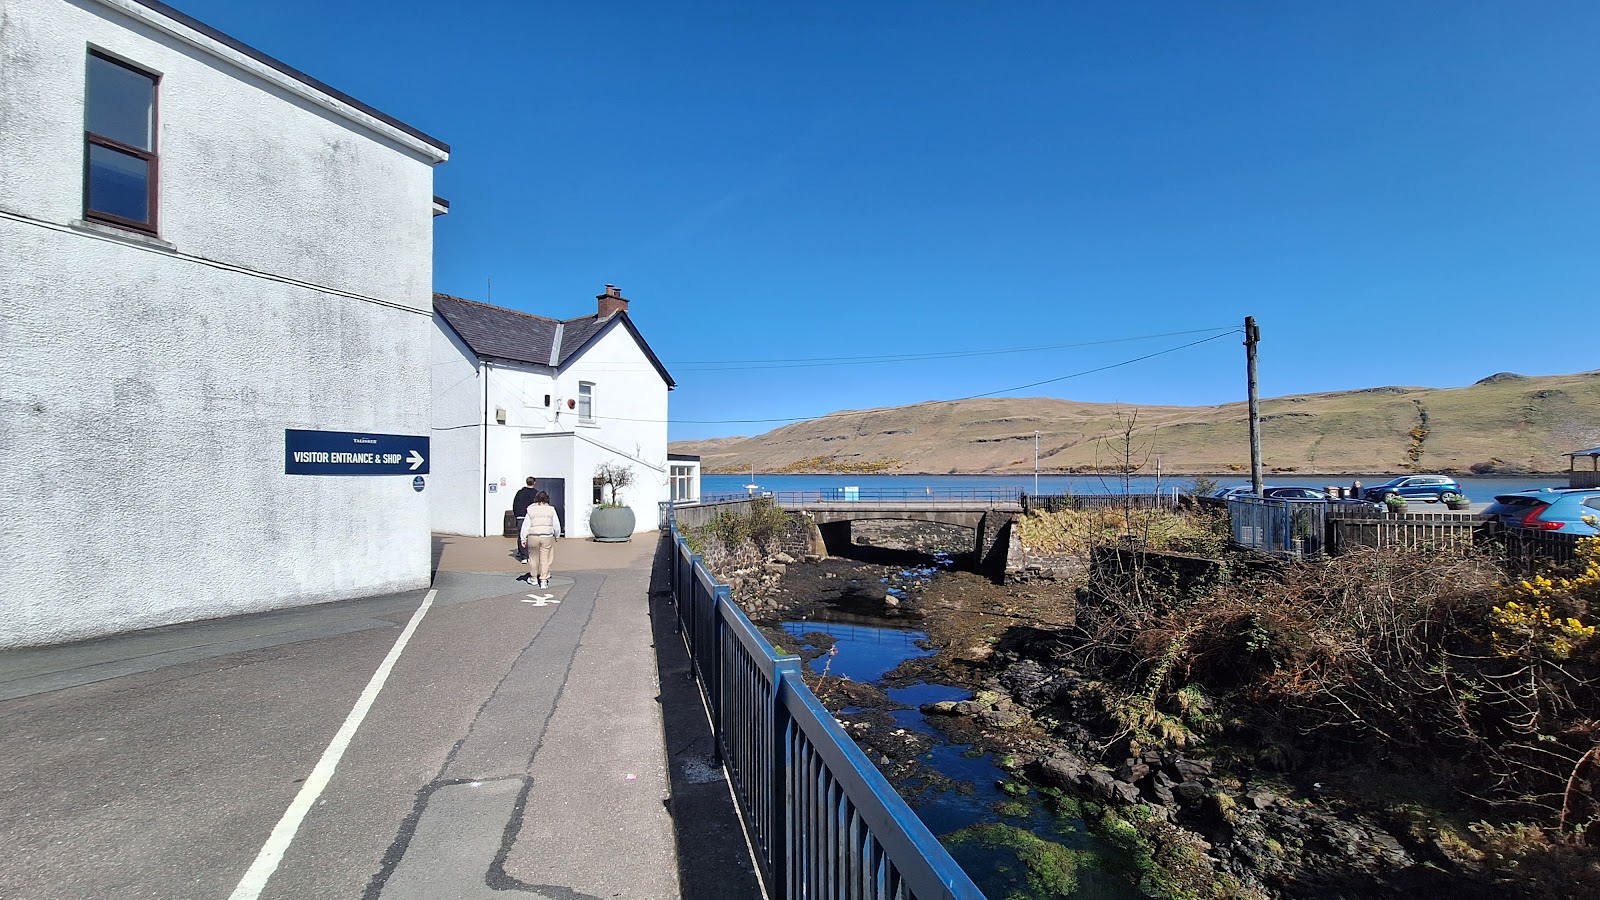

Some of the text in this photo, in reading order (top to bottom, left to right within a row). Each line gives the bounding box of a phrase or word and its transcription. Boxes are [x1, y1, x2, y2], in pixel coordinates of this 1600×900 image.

[294, 452, 402, 464] VISITOR ENTRANCE & SHOP
